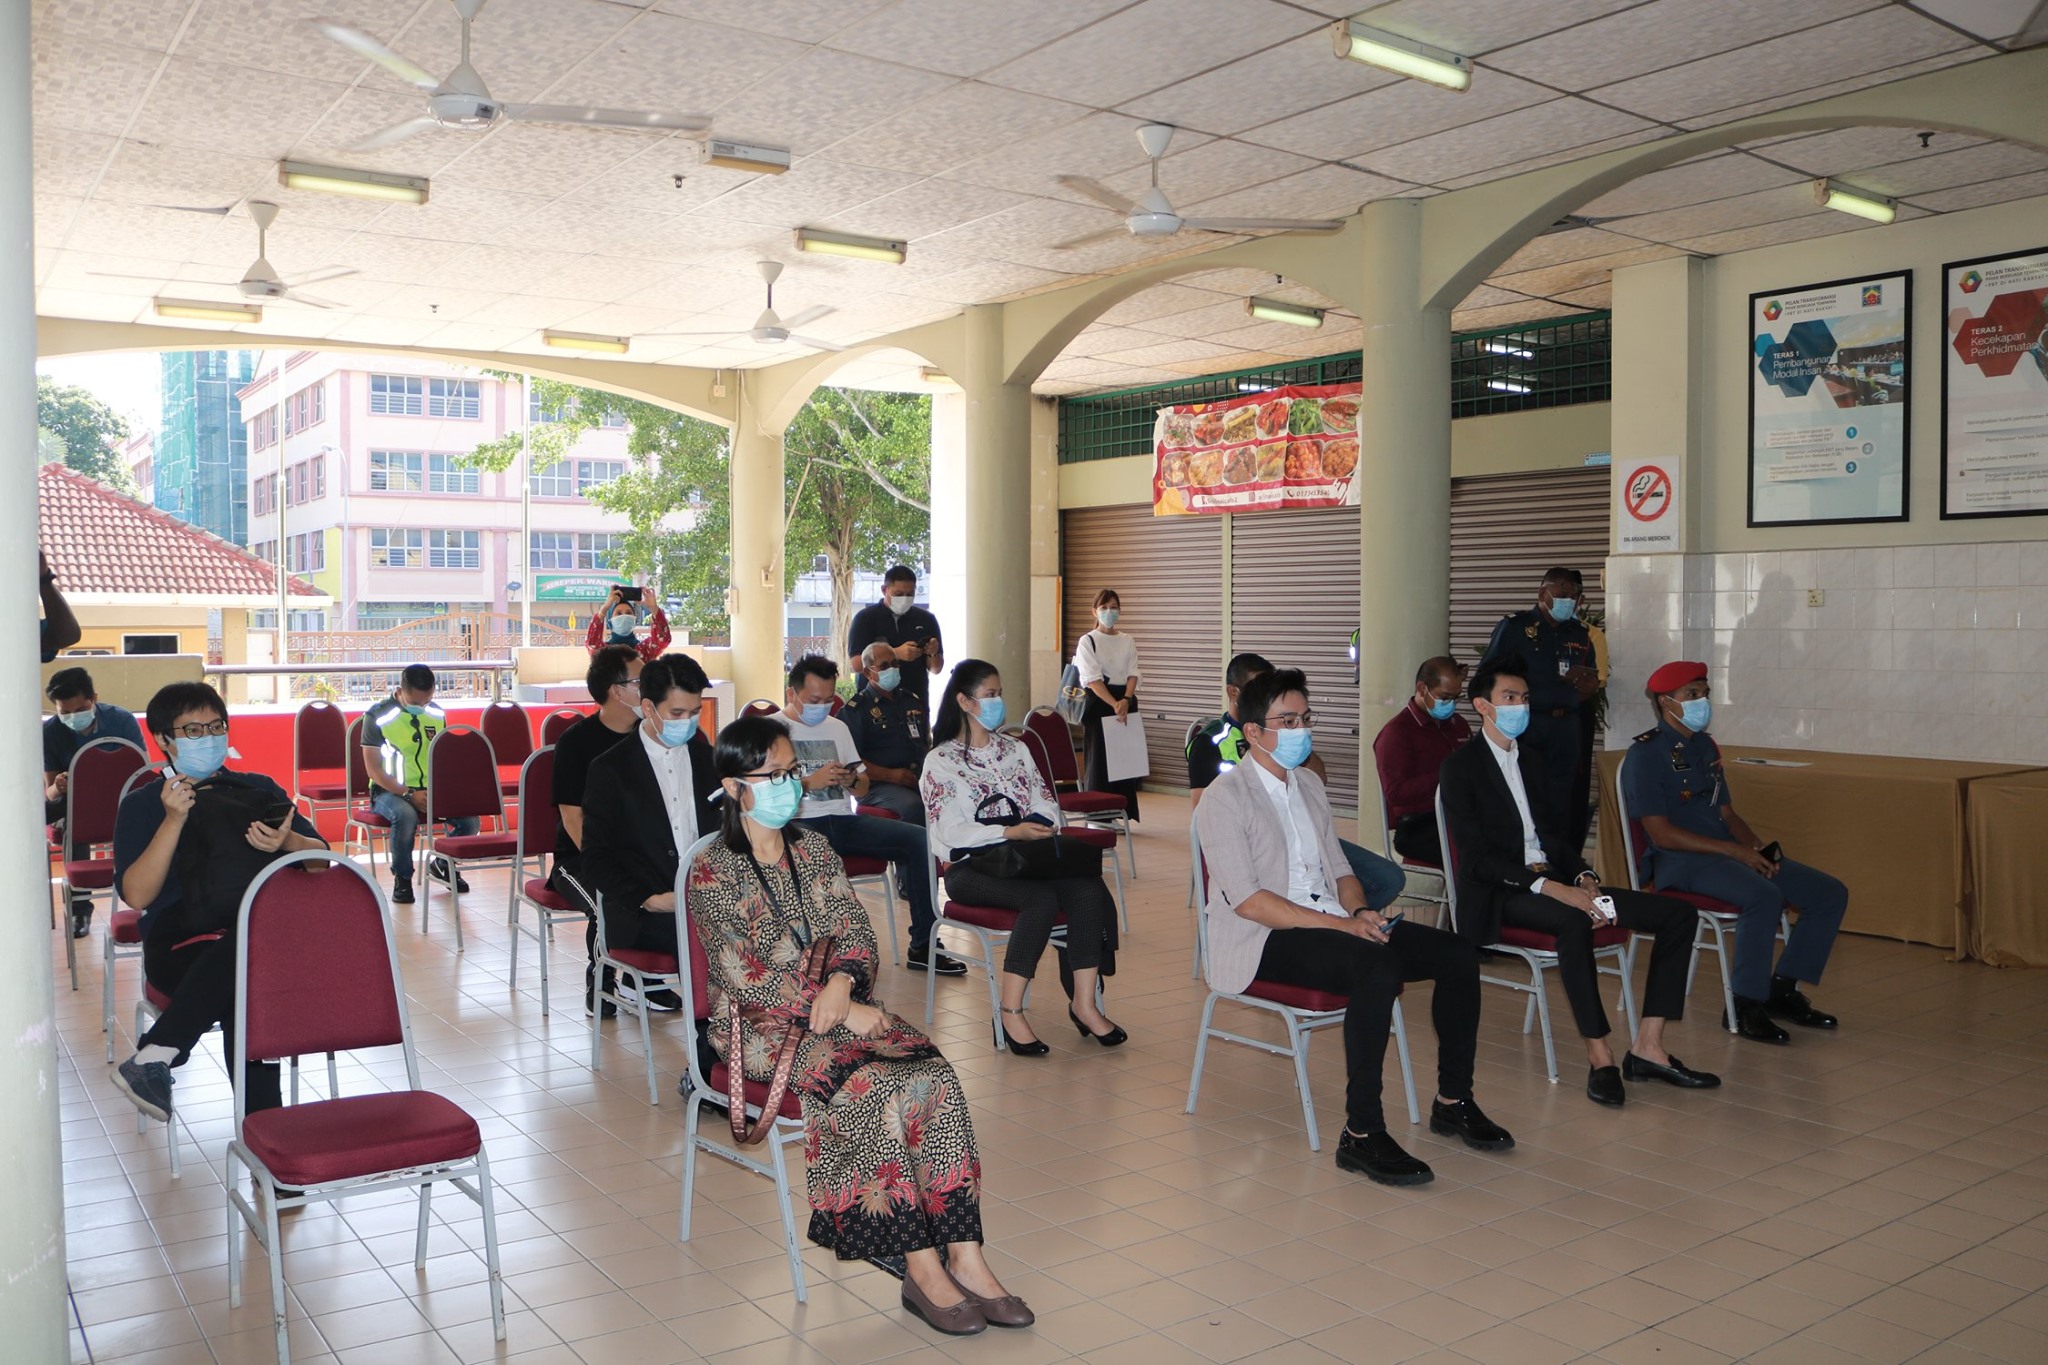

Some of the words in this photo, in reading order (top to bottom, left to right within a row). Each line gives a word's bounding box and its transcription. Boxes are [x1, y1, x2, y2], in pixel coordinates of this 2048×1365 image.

[1971, 326, 1996, 336] TERAS
[1971, 332, 2026, 347] Kecekapan
[1773, 352, 1794, 360] TERAS
[1773, 355, 1831, 369] Pembangunan
[1773, 367, 1798, 379] Modal
[1800, 366, 1821, 376] Insan
[546, 578, 585, 590] KEREPEK
[586, 578, 613, 586] WARI
